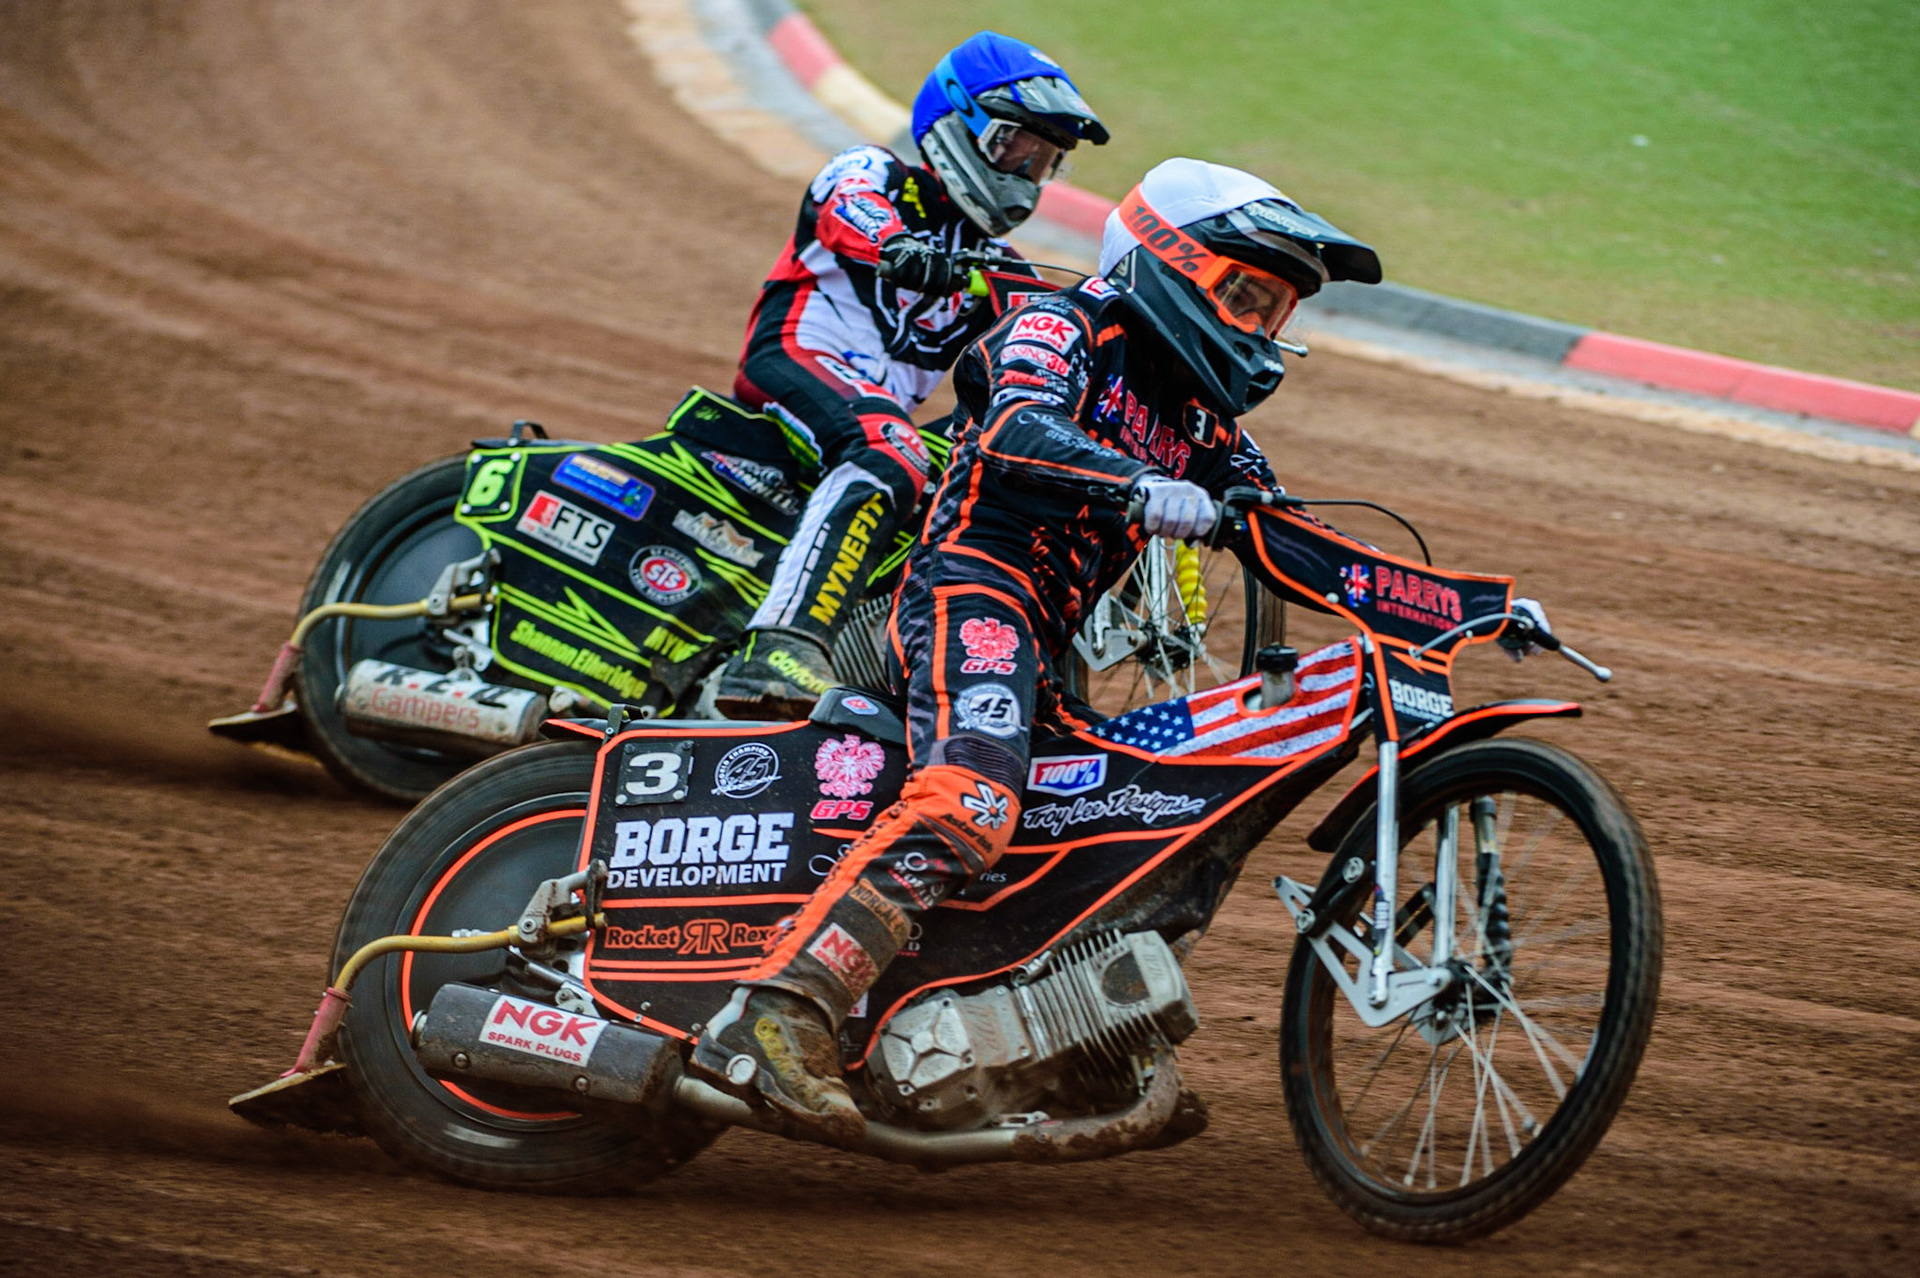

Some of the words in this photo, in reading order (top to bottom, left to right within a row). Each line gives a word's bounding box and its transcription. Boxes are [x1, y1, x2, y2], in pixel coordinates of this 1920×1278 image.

[1128, 205, 1210, 273] 100%
[1014, 315, 1075, 342] NGK
[1193, 408, 1207, 441] 3
[466, 458, 516, 507] 6
[551, 505, 610, 549] FTS
[646, 562, 684, 589] STS
[808, 491, 885, 627] MYNEFIT
[1374, 564, 1463, 622] PARRYS
[1376, 599, 1464, 636] INTERNATION
[960, 658, 1018, 676] GPS
[370, 687, 480, 729] Campers
[971, 698, 1013, 719] 45
[1388, 679, 1456, 718] BORGE
[625, 751, 683, 796] 3
[1038, 760, 1098, 785] 100%
[810, 800, 874, 821] GPS
[608, 812, 795, 869] BORGE
[605, 862, 788, 889] DEVELOPMENT
[606, 926, 679, 947] Rocket
[732, 924, 778, 945] Rex
[492, 1000, 598, 1047] NGK
[487, 1031, 533, 1051] SPARK
[537, 1043, 582, 1062] PLUGS
